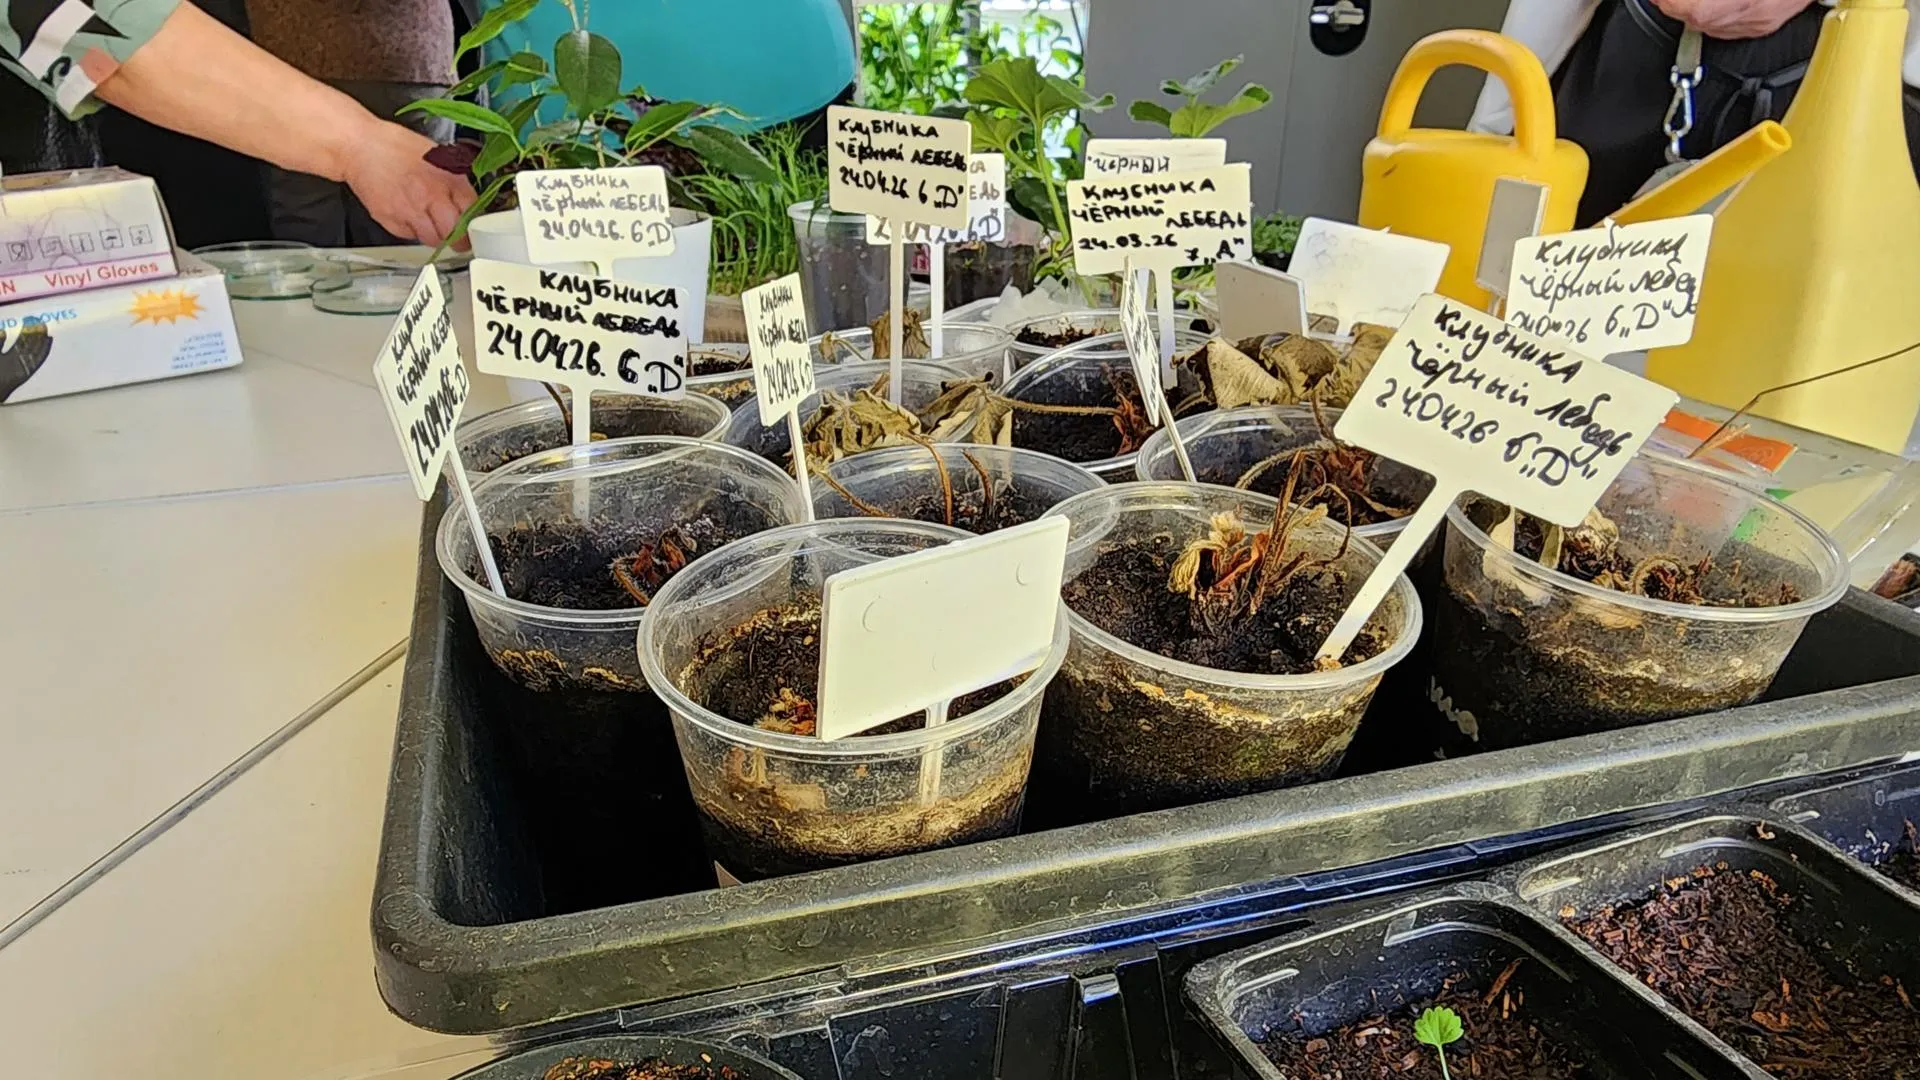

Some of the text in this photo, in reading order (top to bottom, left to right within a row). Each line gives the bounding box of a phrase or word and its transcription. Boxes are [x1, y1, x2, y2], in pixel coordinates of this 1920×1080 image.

[45, 268, 92, 288] Vinyl
[97, 261, 159, 281] Gloves
[539, 269, 679, 308] КЛУБНИКА
